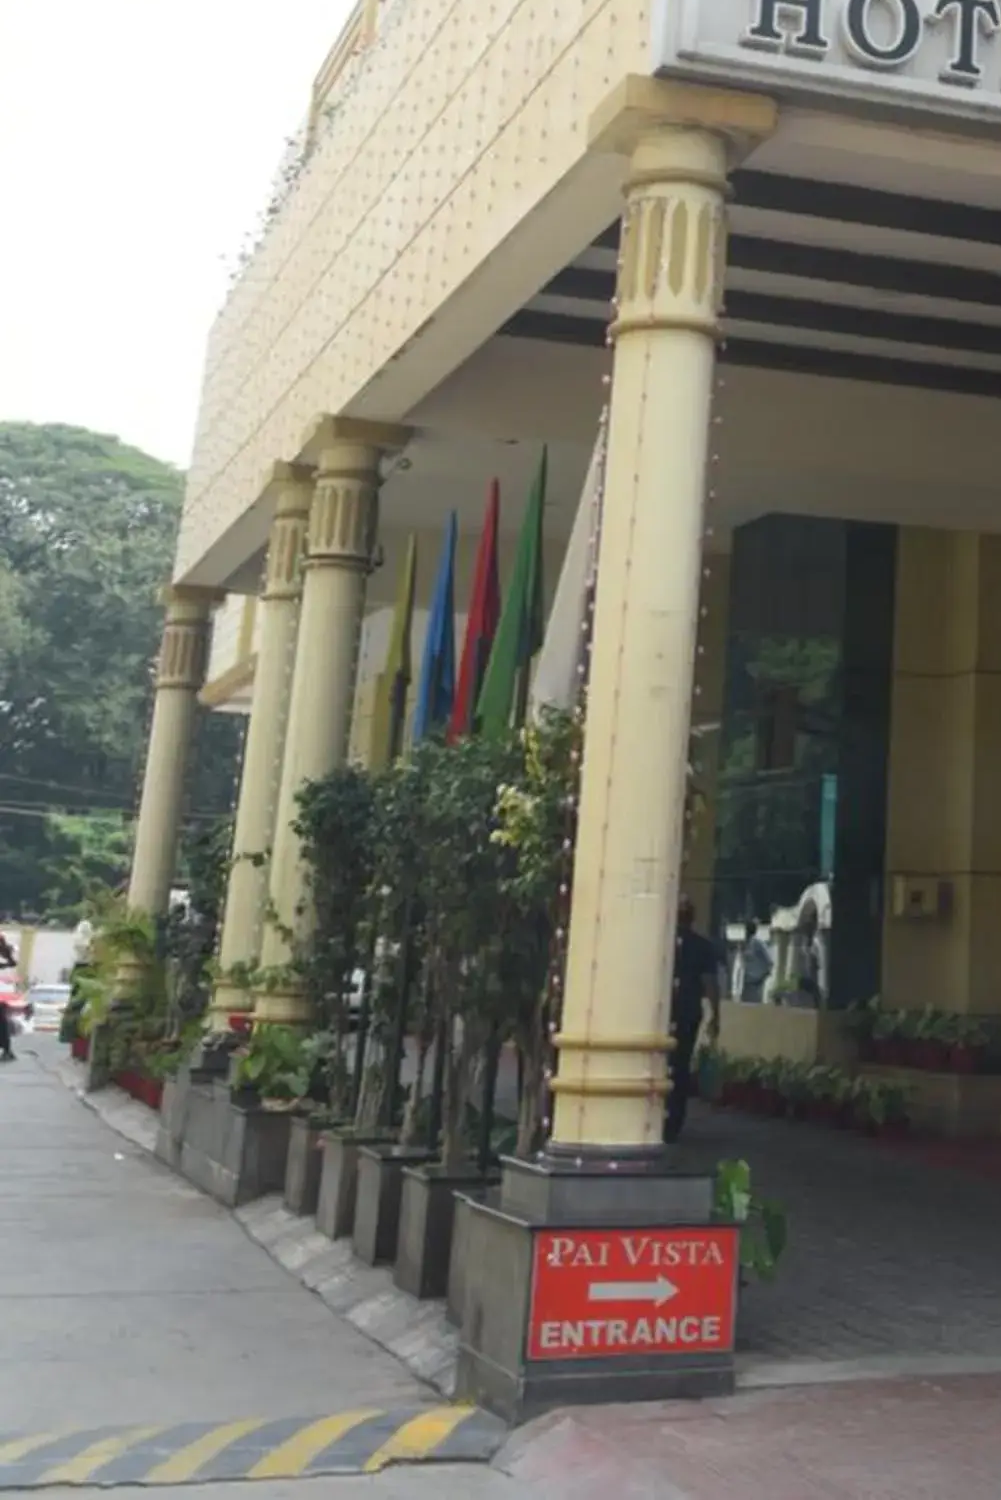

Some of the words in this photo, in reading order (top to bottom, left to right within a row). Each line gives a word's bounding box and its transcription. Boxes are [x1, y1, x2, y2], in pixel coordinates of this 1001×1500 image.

[547, 1236, 610, 1268] PAI
[620, 1235, 724, 1267] VISTA
[540, 1315, 721, 1349] ENTRANCE
